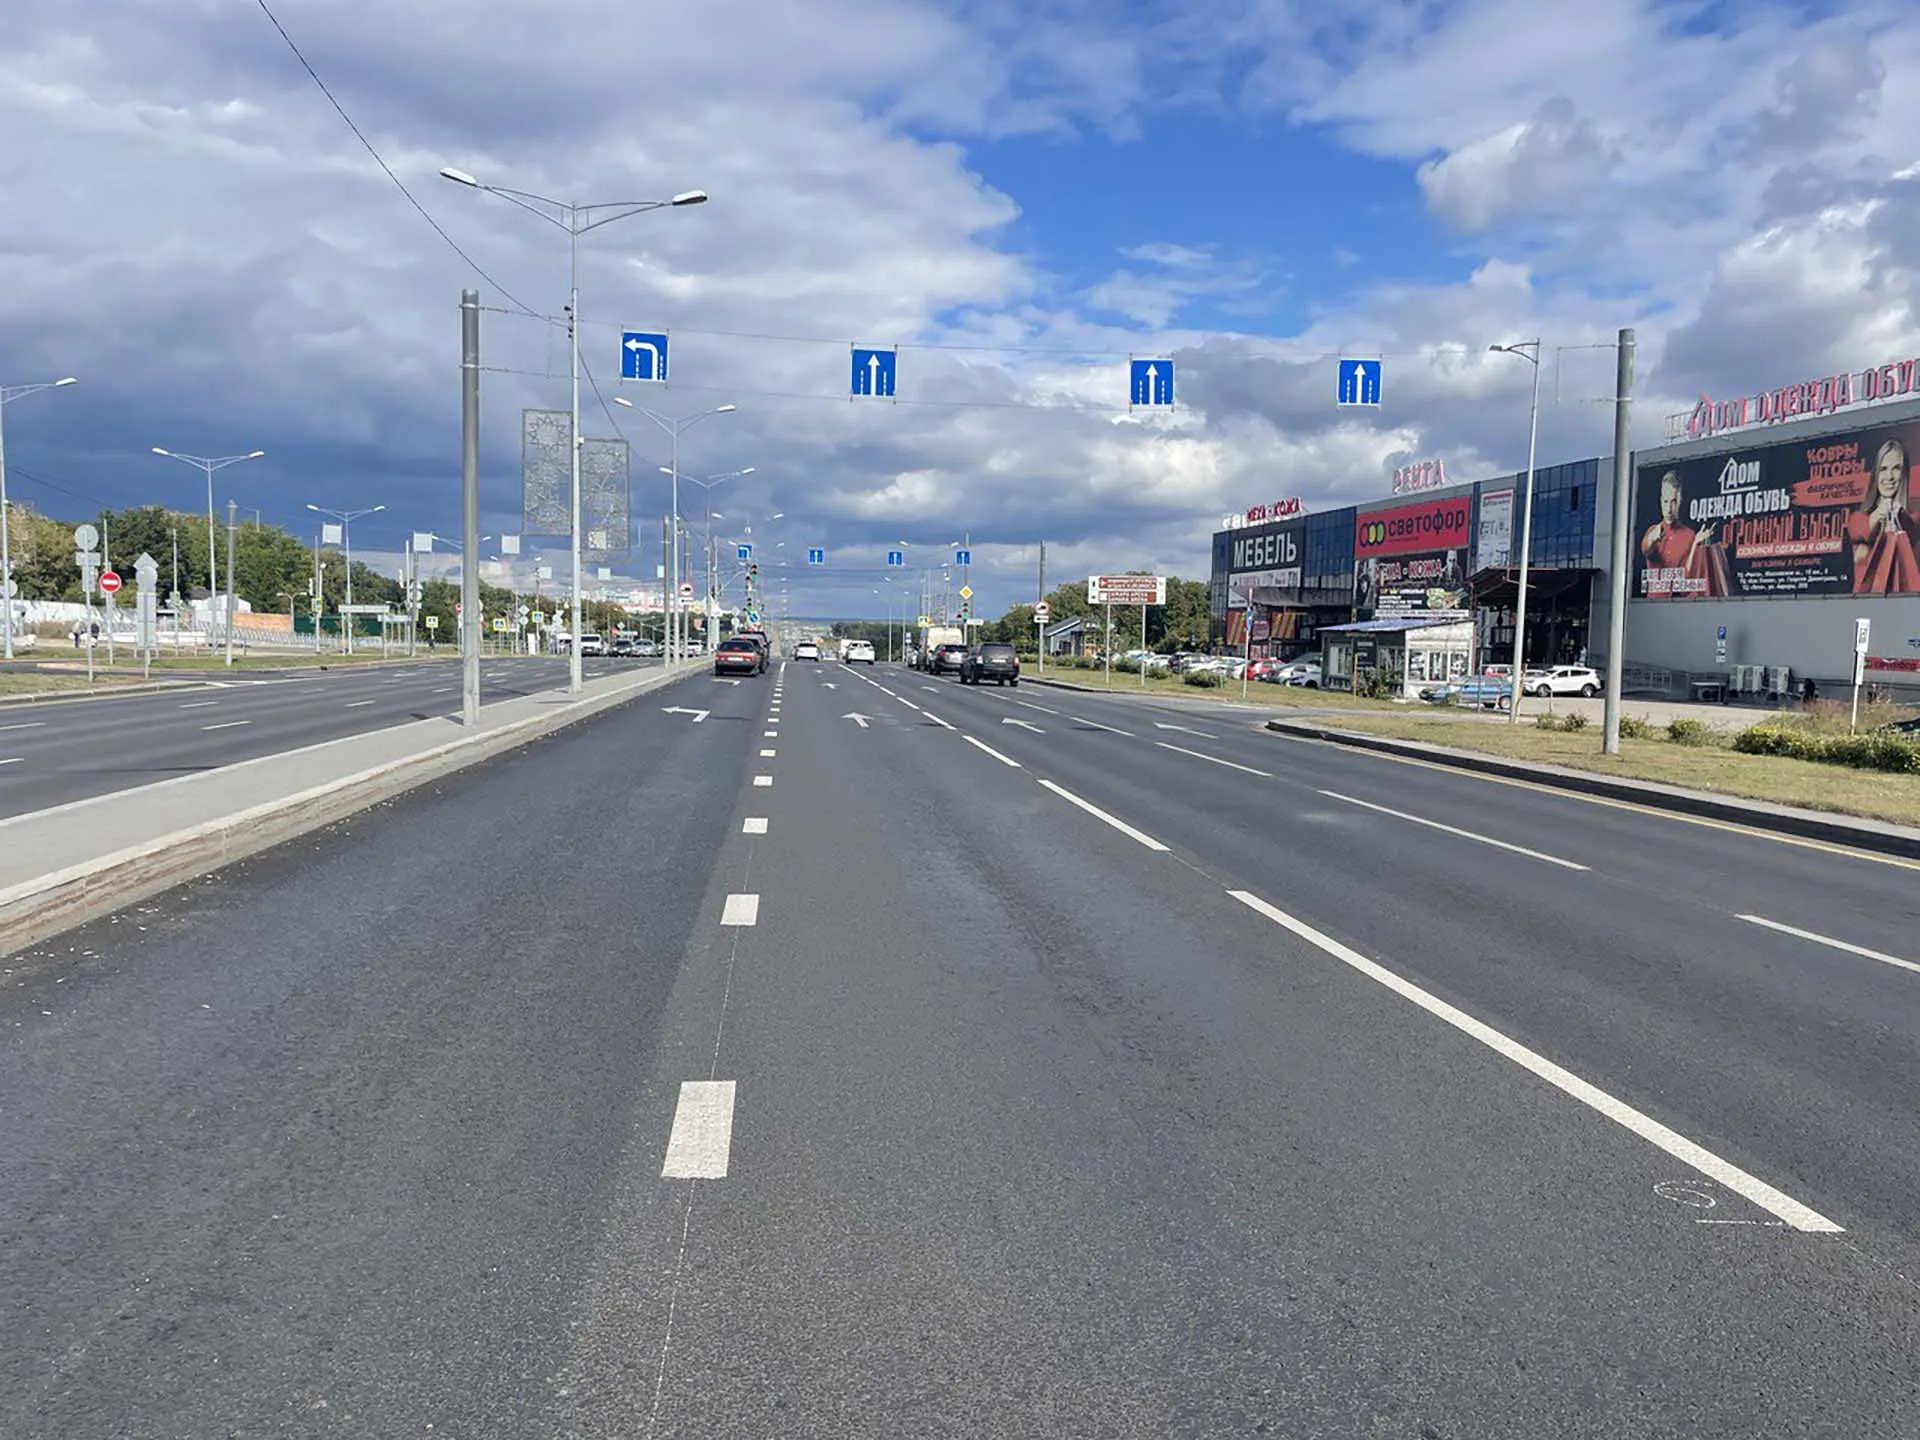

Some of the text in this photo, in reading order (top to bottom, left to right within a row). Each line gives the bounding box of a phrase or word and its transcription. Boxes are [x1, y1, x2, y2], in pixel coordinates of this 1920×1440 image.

[1695, 393, 1747, 437] ДОМ
[1755, 374, 1853, 424] ОДЕЖДА
[1807, 442, 1858, 464] КОВРЫ
[1726, 461, 1760, 489] ДОМ
[1809, 457, 1866, 480] ШТОРЫ
[1274, 497, 1302, 517] КОЖА
[1689, 488, 1790, 522] ОДЕЖДА ОБУВЬ
[1388, 508, 1465, 537] светофор
[1722, 507, 1850, 547] ОГРОМНЫЙ ВЫБОР
[1233, 531, 1297, 569] МЕБЕЛЬ
[1407, 559, 1442, 580] КОЖА
